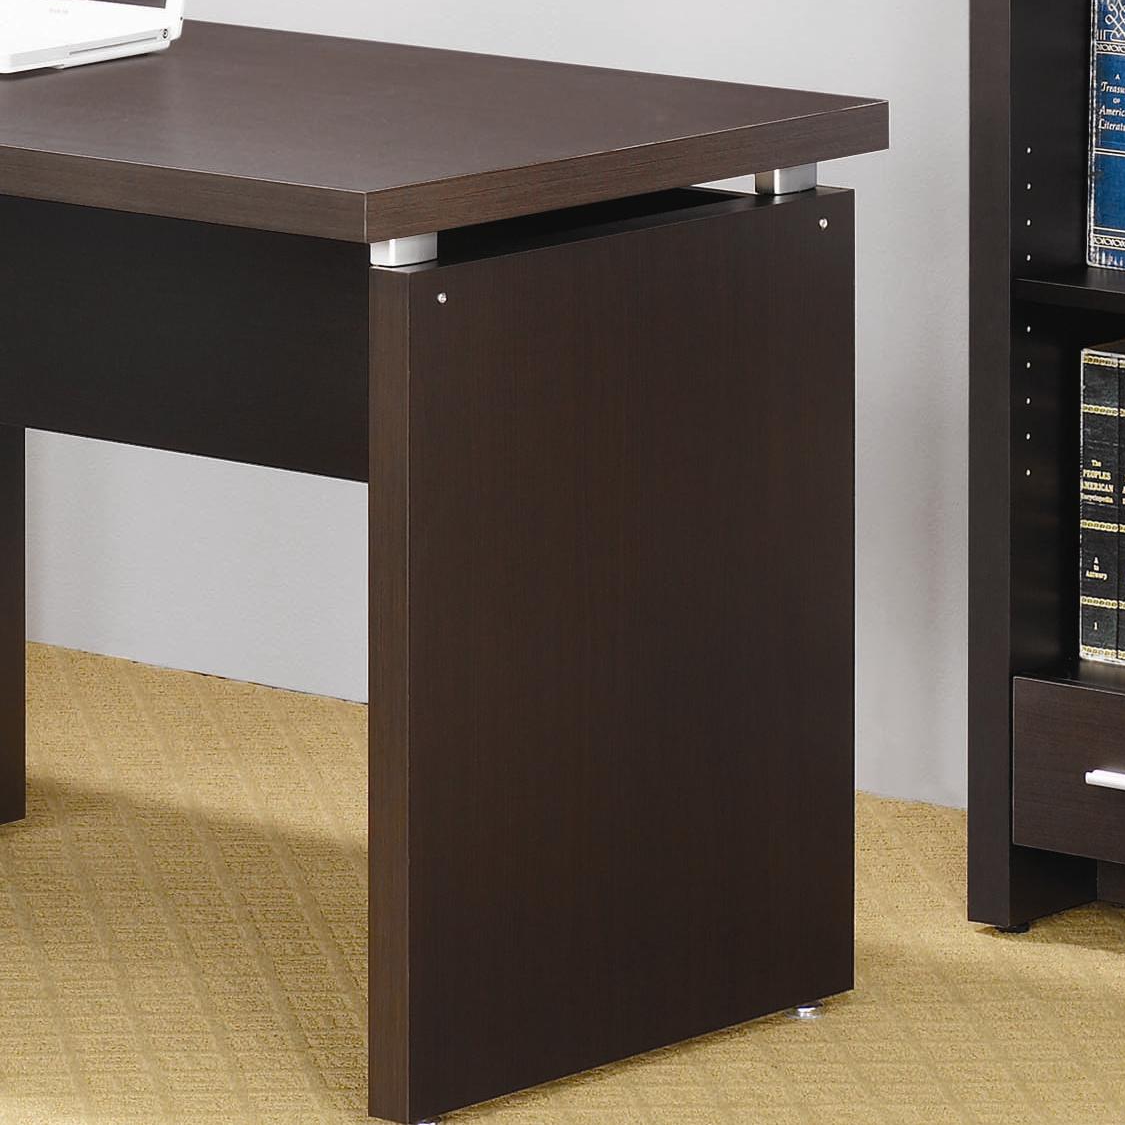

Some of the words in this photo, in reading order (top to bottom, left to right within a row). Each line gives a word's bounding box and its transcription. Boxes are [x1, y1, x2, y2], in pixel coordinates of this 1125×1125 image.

[1082, 469, 1111, 481] PEOPLES
[1081, 481, 1114, 493] AMERICAN
[1093, 621, 1098, 631] 1
